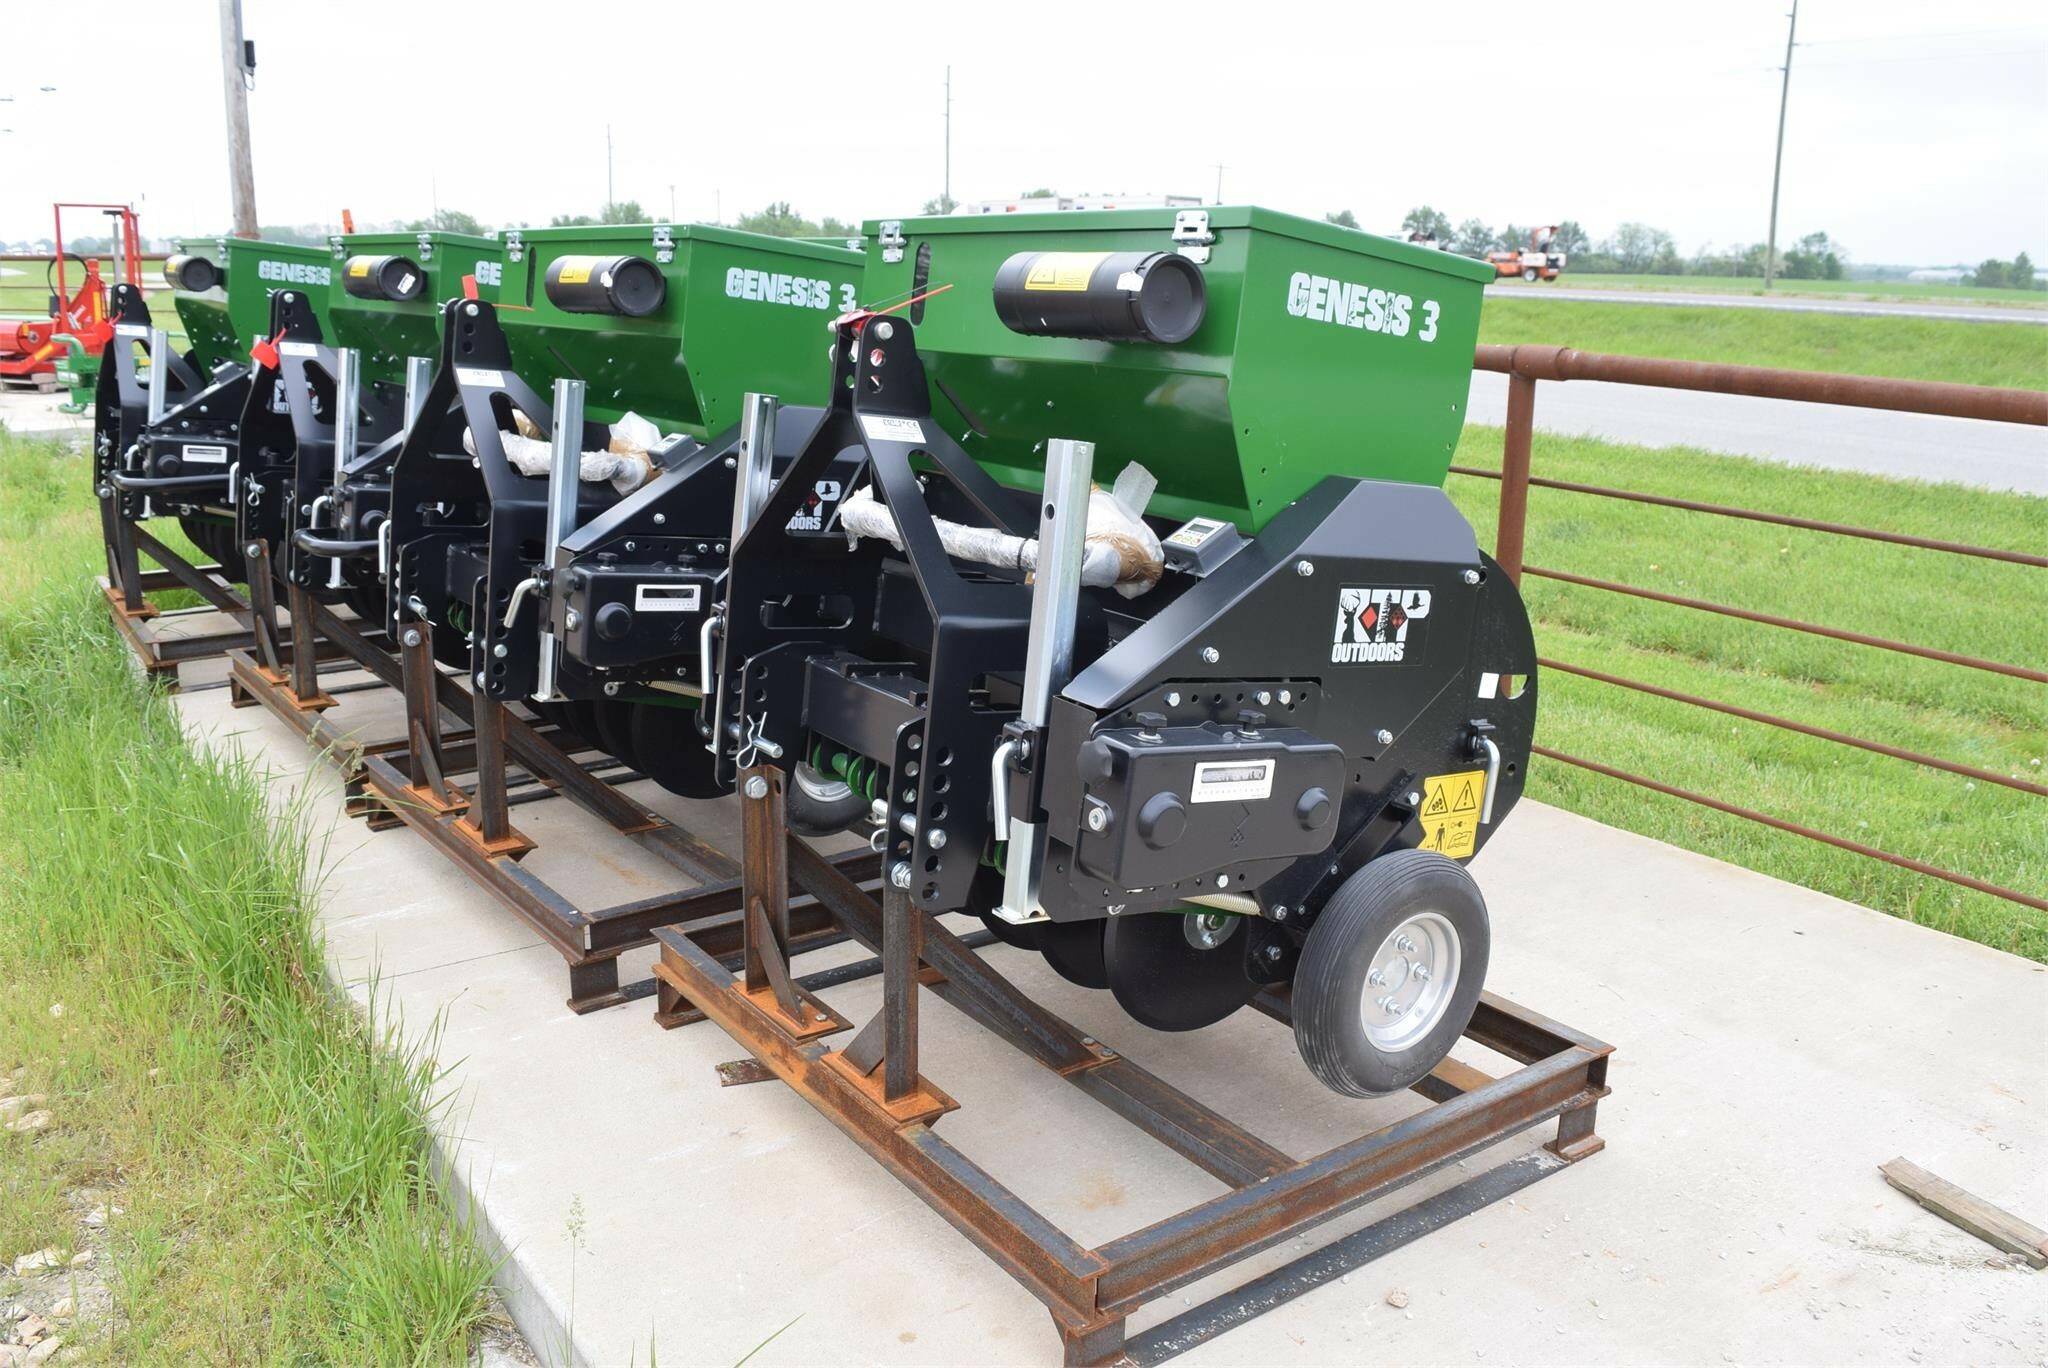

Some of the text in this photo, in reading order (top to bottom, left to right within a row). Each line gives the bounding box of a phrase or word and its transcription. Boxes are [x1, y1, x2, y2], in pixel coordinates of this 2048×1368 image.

[258, 260, 331, 286] GENESIS
[725, 266, 856, 313] GENESIS 3
[1286, 271, 1441, 343] GENESIS 3
[1333, 588, 1432, 643] RTP
[1331, 642, 1405, 663] OUTDOORS
